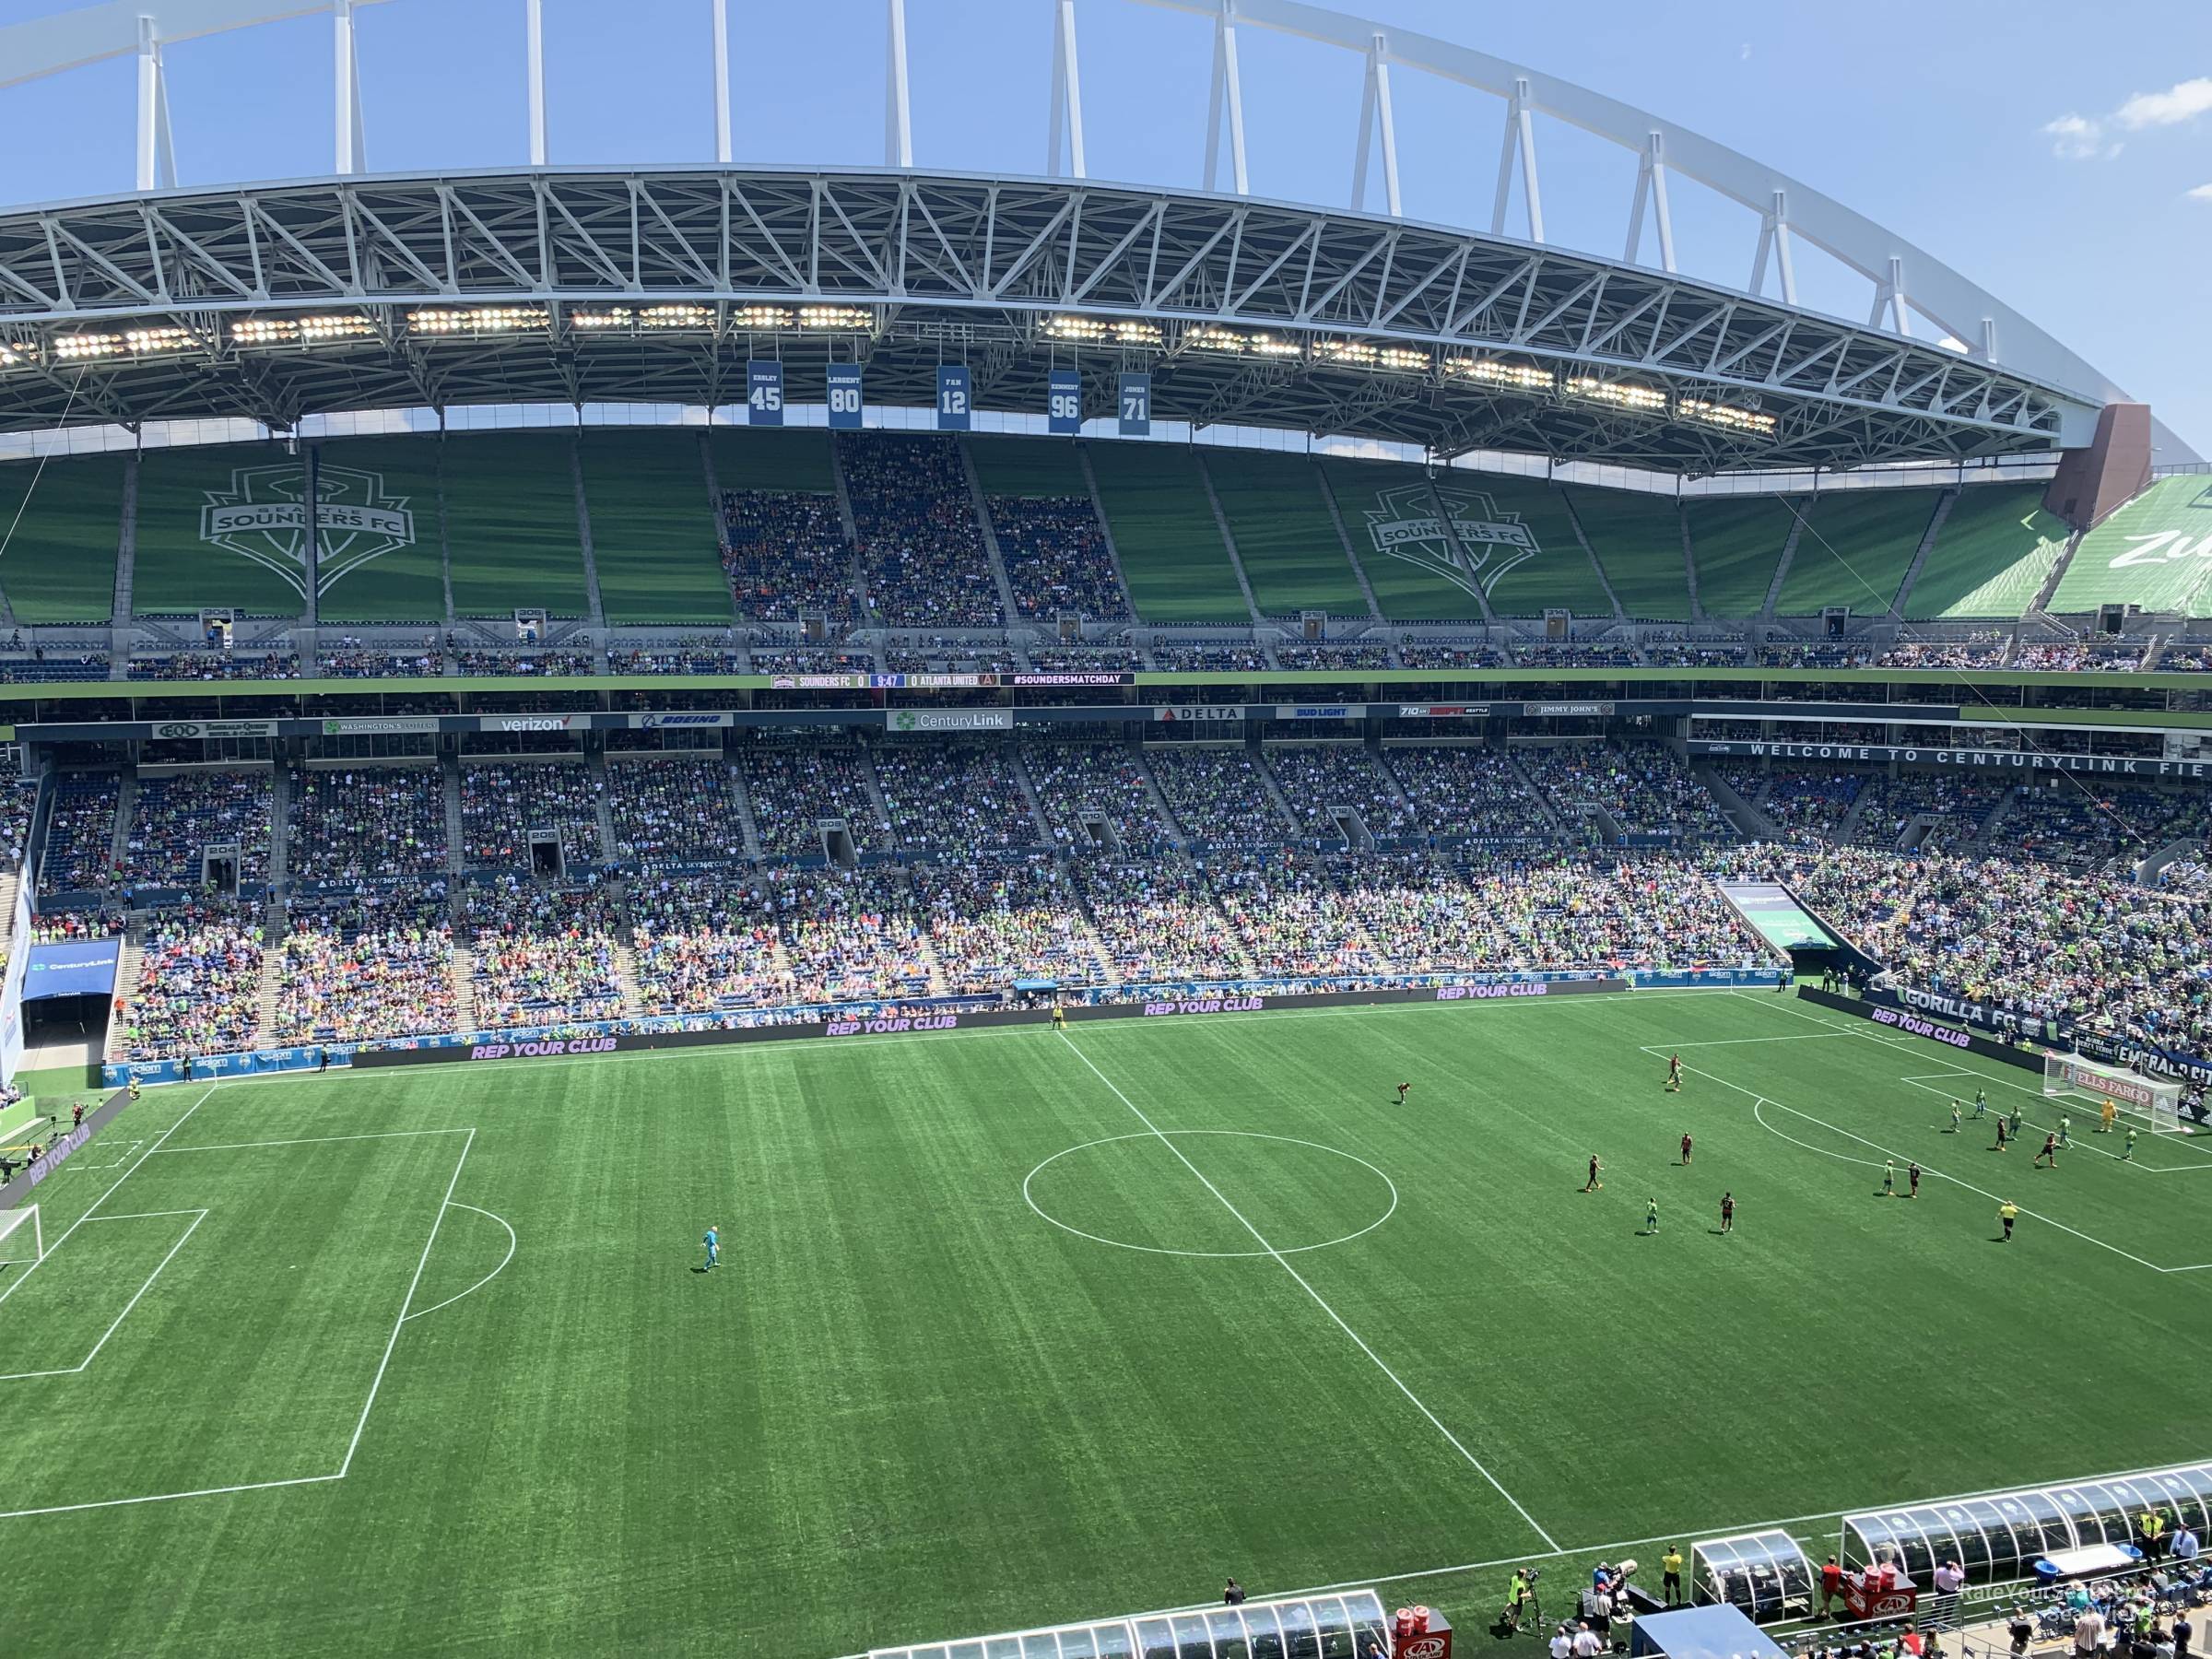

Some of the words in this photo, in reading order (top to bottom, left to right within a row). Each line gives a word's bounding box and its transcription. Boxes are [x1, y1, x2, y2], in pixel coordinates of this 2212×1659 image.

[750, 387, 780, 411] 45
[831, 389, 859, 412] 80
[942, 391, 965, 414] 12
[1052, 395, 1078, 418] 96
[1124, 398, 1146, 420] 71
[371, 518, 400, 532] FC
[1497, 531, 1526, 544] FC
[800, 677, 838, 687] SOUNDERS
[841, 677, 850, 687] FC
[858, 677, 864, 687] 0
[877, 677, 897, 687] 9:47
[912, 677, 917, 686] 0
[920, 677, 951, 686] ATLANTA
[953, 677, 977, 685] UNITED
[1014, 675, 1121, 685] #SOUNDERSMATCHDAY
[661, 715, 721, 724] BOEING
[920, 714, 1003, 728] CenturyLink
[1181, 709, 1237, 718] DELTA
[1297, 708, 1317, 717] BUD
[1318, 708, 1347, 717] LIGHT
[501, 715, 563, 731] verizon
[1751, 744, 1869, 759] WELCOME
[1888, 750, 1917, 761] TO
[1937, 752, 2136, 773] CENTURYLINK
[49, 959, 114, 970] CenturyLink
[1436, 987, 1467, 1000] REP
[1469, 985, 1508, 998] YOUR
[1510, 983, 1547, 996] CLUB
[1144, 1002, 1176, 1016] REP
[1178, 1000, 1221, 1014] YOUR
[1224, 998, 1263, 1012] CLUB
[1905, 989, 1983, 1022] GORILLA
[827, 1022, 861, 1036] REP
[863, 1018, 910, 1033] YOUR
[914, 1015, 958, 1030] CLUB
[1871, 1008, 1897, 1025] REP
[1899, 1014, 1933, 1037] YOUR
[1935, 1027, 1971, 1048] CLUB
[471, 1045, 508, 1060] REP
[512, 1041, 565, 1057] YOUR
[568, 1038, 617, 1053] CLUB
[2108, 1081, 2149, 1102] FARGO
[29, 1158, 47, 1186] REP
[46, 1140, 71, 1170] YOUR
[69, 1123, 90, 1151] CLUB
